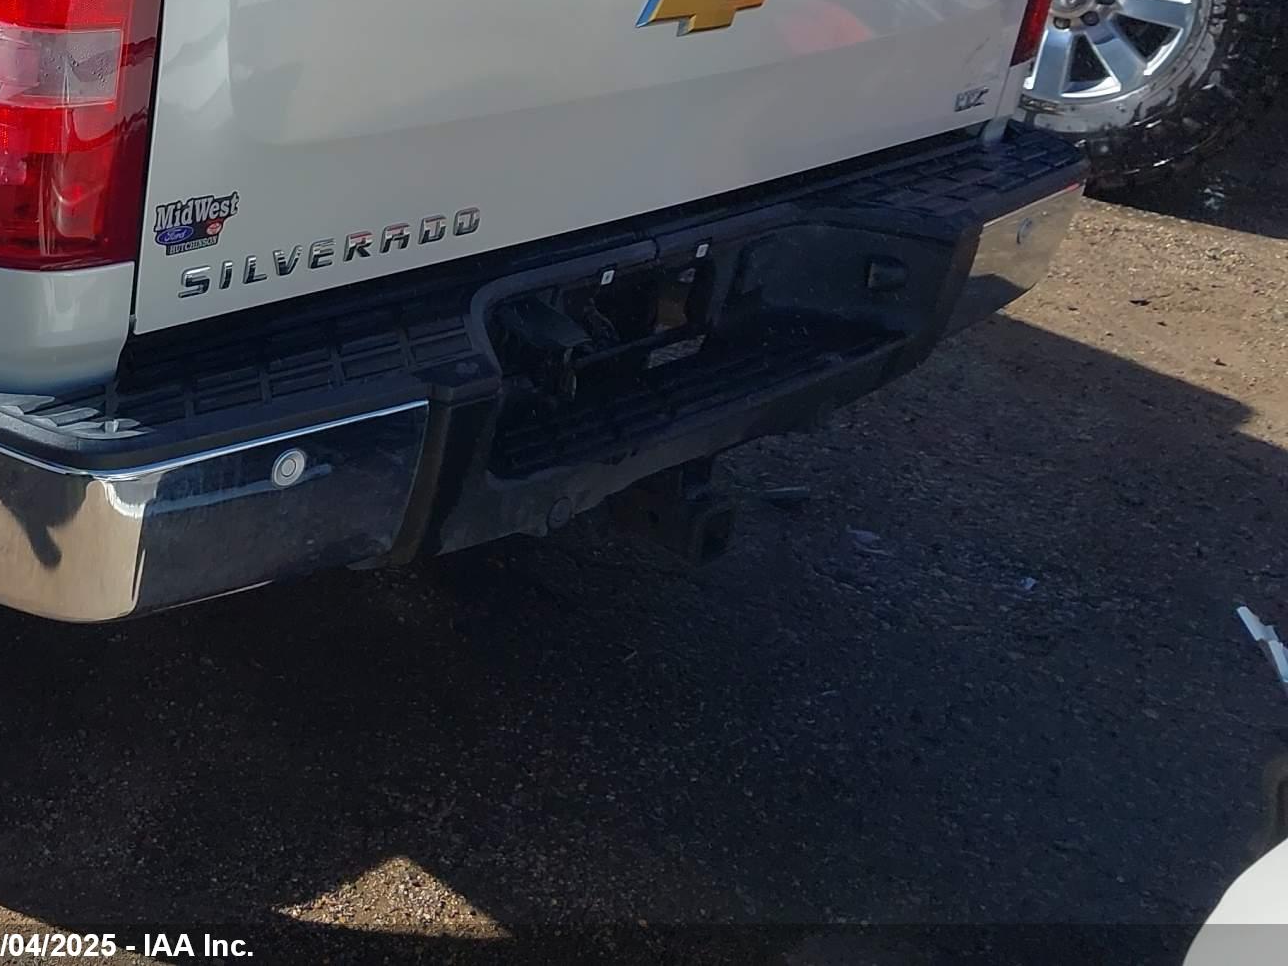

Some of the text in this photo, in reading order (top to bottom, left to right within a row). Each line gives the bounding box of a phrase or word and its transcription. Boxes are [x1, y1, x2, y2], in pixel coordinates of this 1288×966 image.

[155, 191, 239, 231] MidWest
[169, 236, 218, 254] HUTCHINSON
[177, 206, 481, 299] SILVERADO
